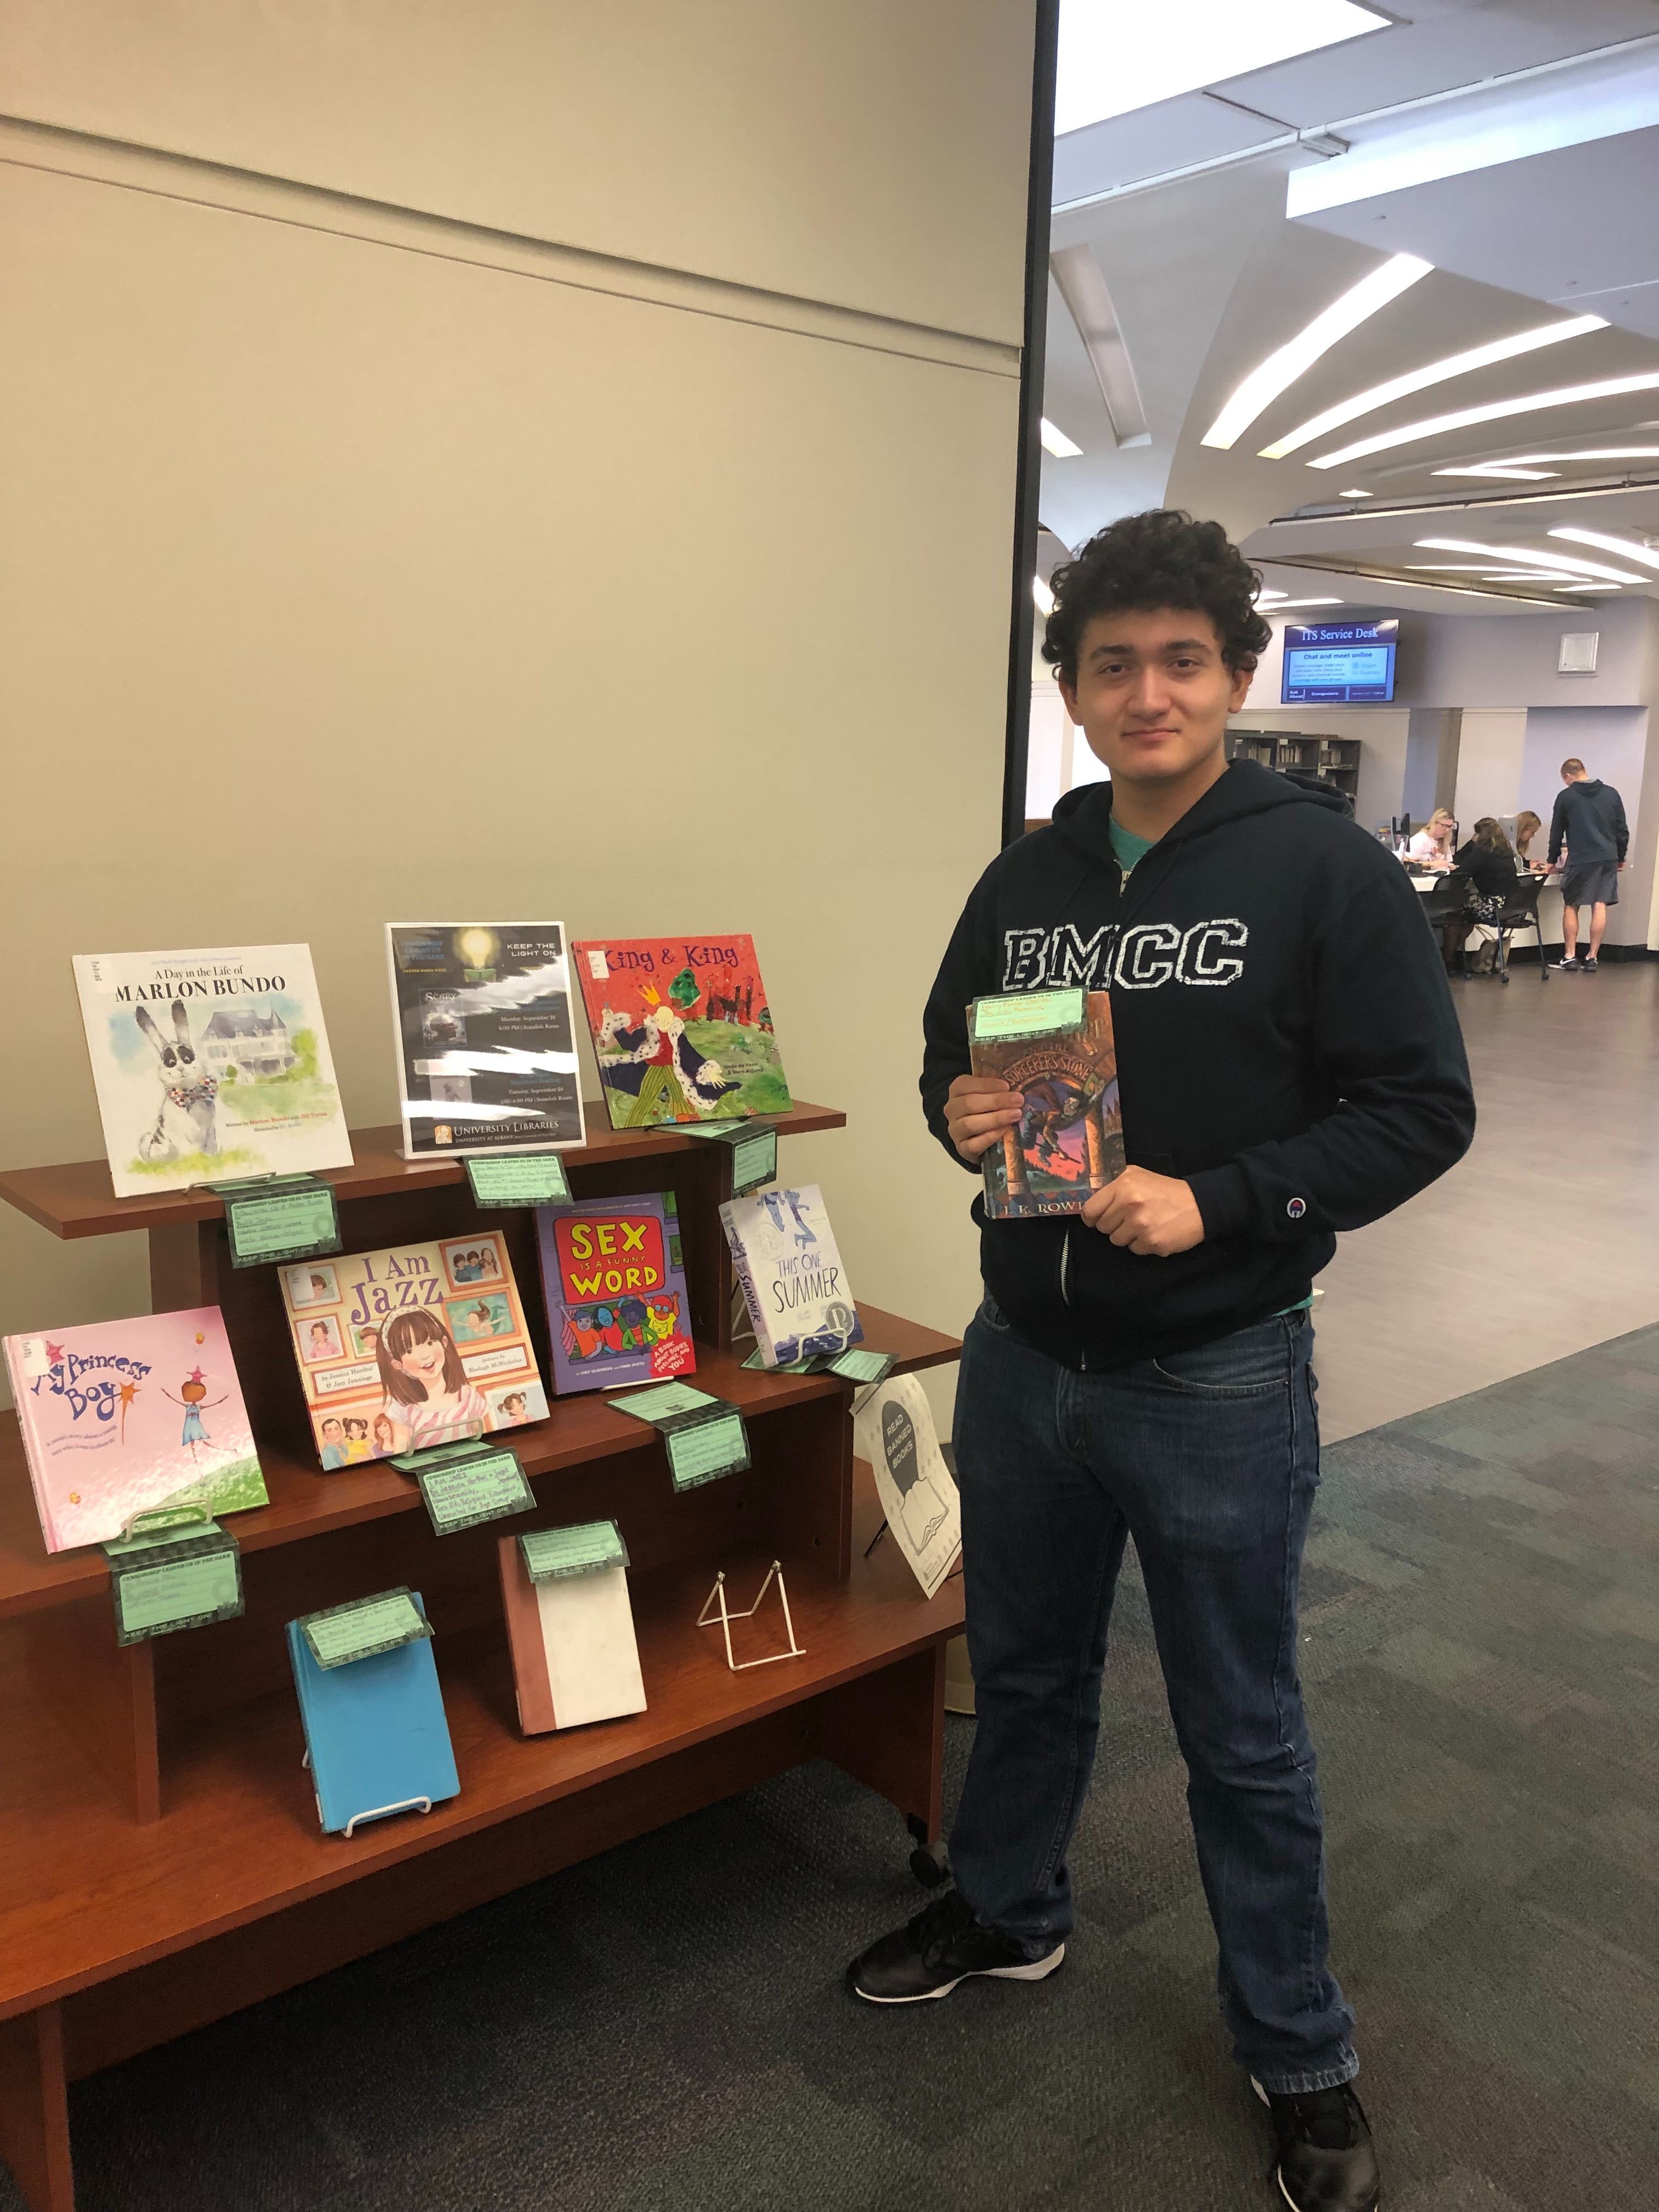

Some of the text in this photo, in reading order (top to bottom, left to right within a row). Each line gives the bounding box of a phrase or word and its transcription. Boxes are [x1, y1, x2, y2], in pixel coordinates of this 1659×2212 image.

[1302, 628, 1378, 641] ITS Service Desk
[661, 948, 675, 965] &
[681, 945, 739, 968] King
[1002, 918, 1249, 991] BMCC
[155, 965, 243, 980] A Day in the Life of
[115, 975, 286, 1002] MARLON BUNDO
[454, 1125, 510, 1136] UNIVERSITY
[514, 1120, 559, 1132] LIBRARIES
[571, 1222, 647, 1260] SEX
[361, 1255, 430, 1283] I Am
[607, 1255, 645, 1267] FUNNY
[775, 1251, 822, 1278] THIS ONE
[569, 1266, 658, 1297] WORD
[772, 1267, 842, 1313] SUMMER
[737, 1274, 761, 1323] SUMMER
[654, 1351, 669, 1368] ABOUT
[658, 1341, 675, 1353] BOOK
[67, 1354, 152, 1385] Princess
[469, 1365, 489, 1374] Shelagh
[668, 1358, 684, 1370] YOU
[347, 1375, 373, 1386] Jennings
[64, 1382, 121, 1421] Boy
[887, 1414, 904, 1438] READ
[887, 1423, 912, 1457] BANNED
[892, 1440, 913, 1470] BOOKS
[475, 1511, 494, 1519] LIGHT
